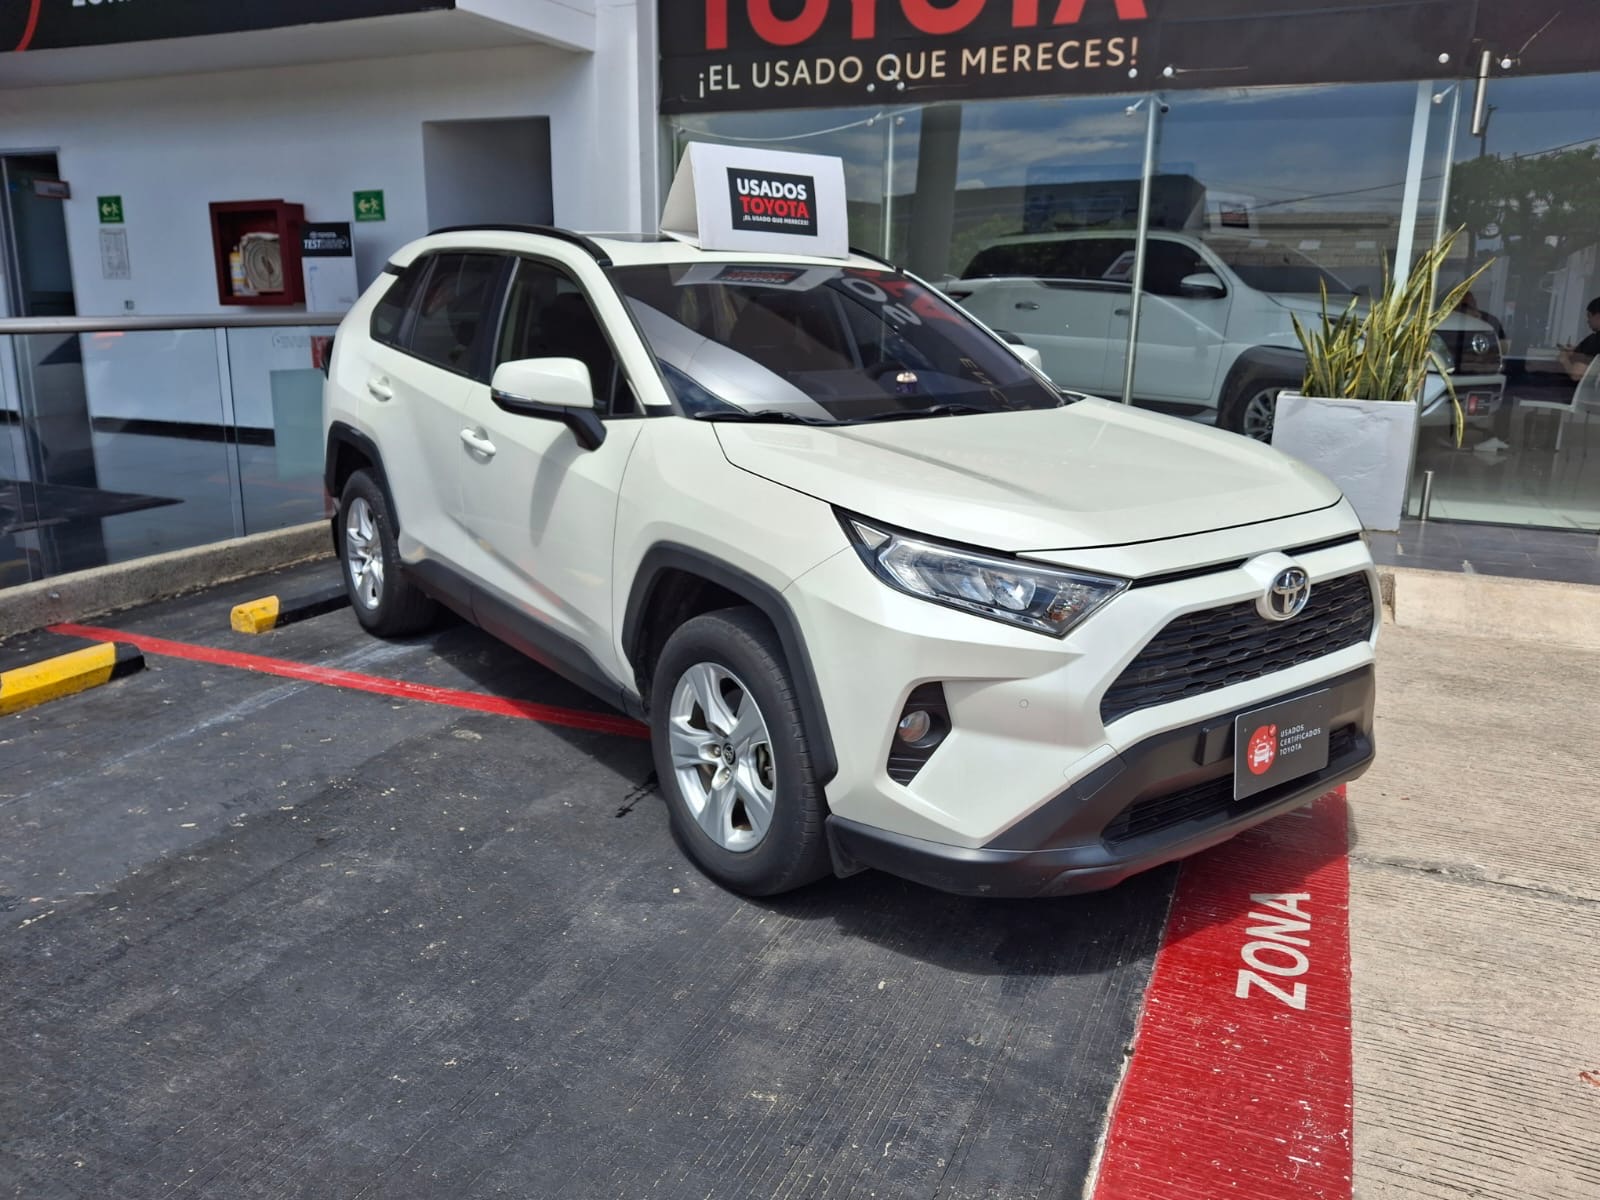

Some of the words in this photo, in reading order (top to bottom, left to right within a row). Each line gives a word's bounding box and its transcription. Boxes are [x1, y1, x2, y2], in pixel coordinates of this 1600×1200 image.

[699, 64, 741, 98] ¡EL
[752, 56, 863, 88] USADO
[876, 50, 946, 82] QUE
[961, 37, 1138, 76] MERECES!
[736, 178, 807, 200] USADOS
[739, 195, 810, 218] TOYOTA
[1280, 724, 1305, 738] USADOS
[1280, 728, 1321, 747] CERTIFICADOS
[1280, 743, 1302, 756] TOYOTA
[1235, 893, 1311, 1010] ZONA
